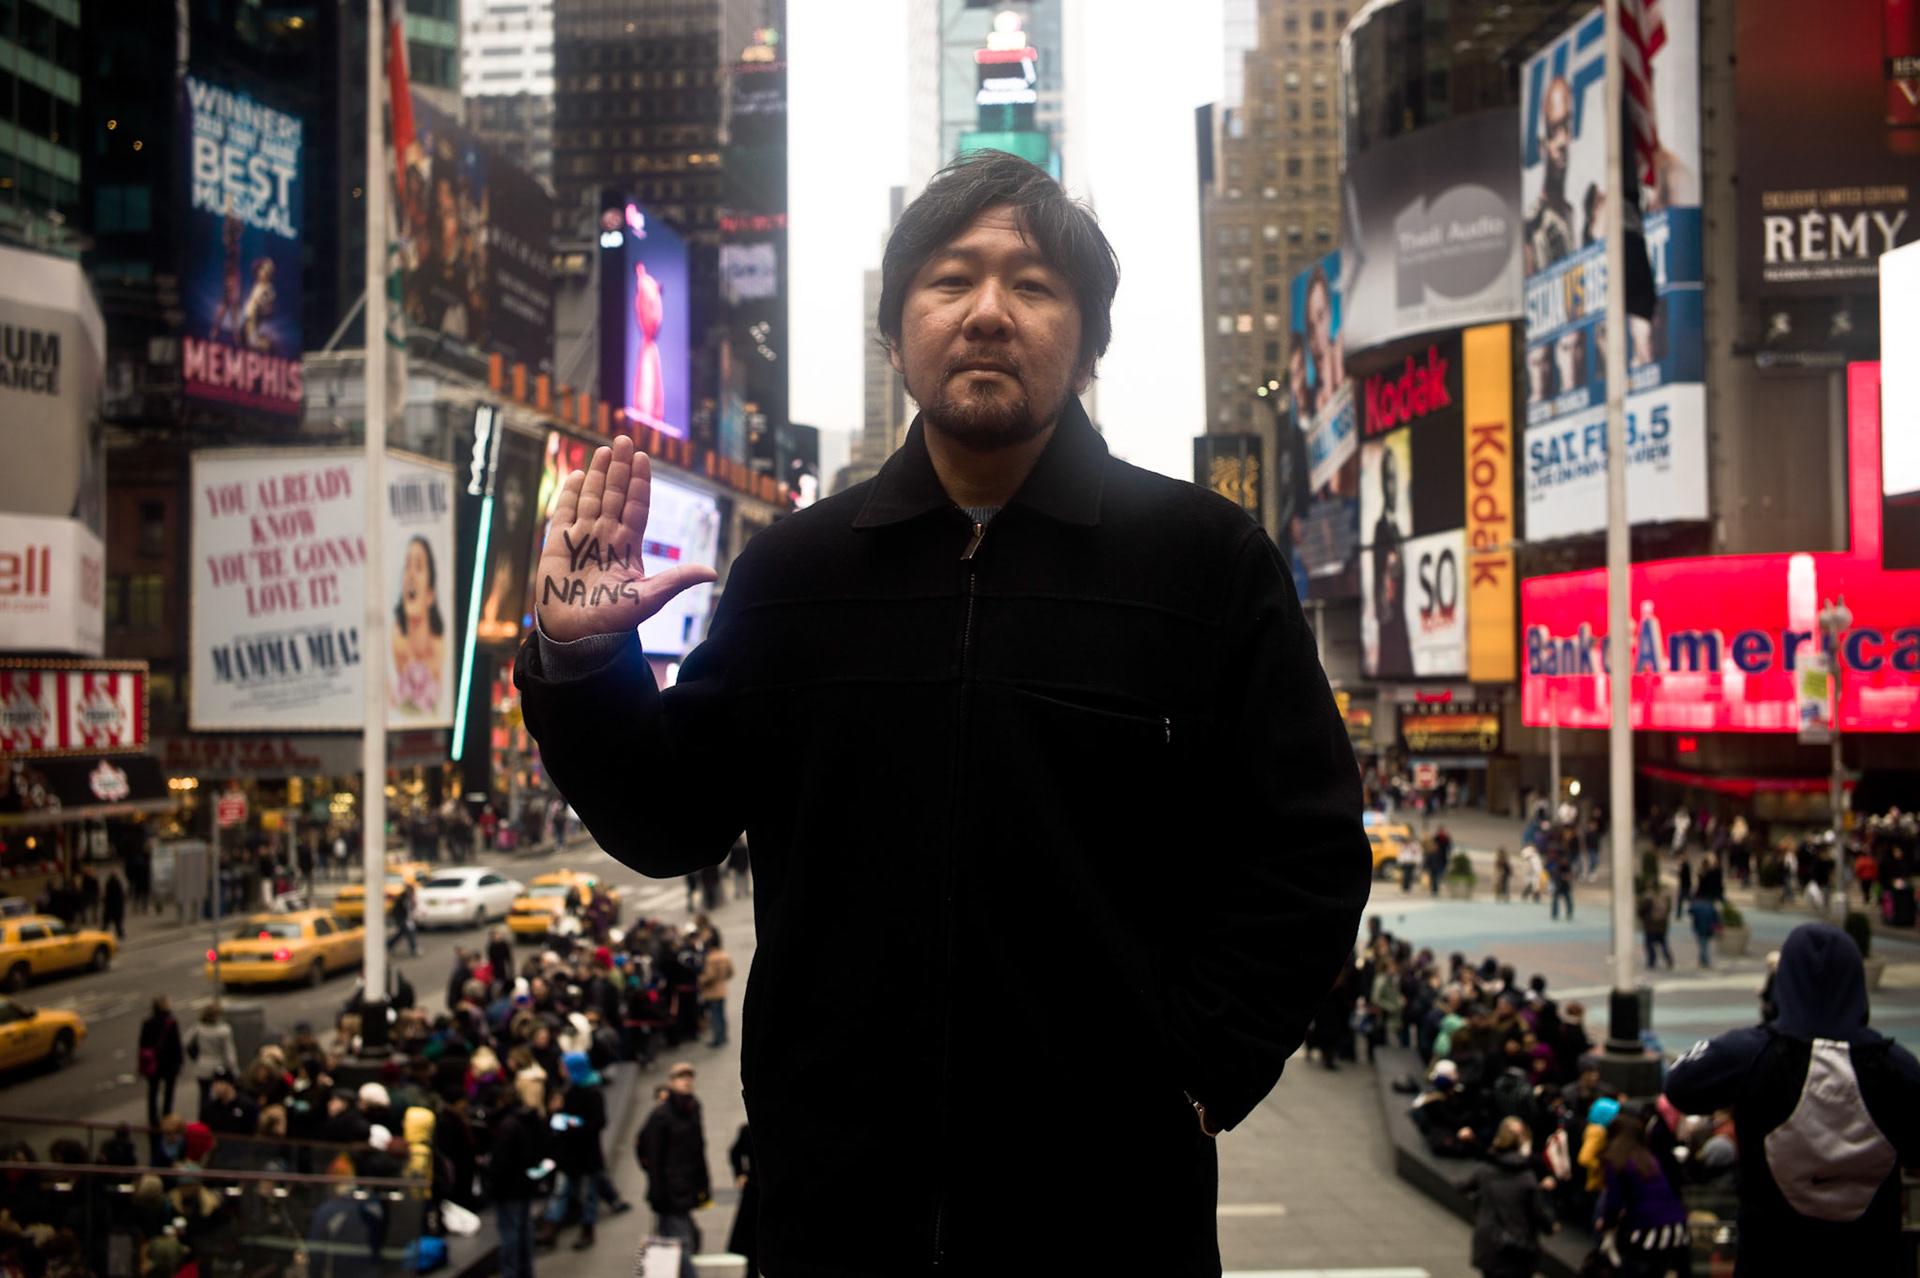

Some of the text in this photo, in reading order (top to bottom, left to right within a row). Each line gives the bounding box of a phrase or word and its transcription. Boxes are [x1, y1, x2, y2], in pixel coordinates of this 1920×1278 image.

[192, 135, 297, 209] BEST
[1762, 184, 1908, 211] EXCLUSIVE LIMITED EDITION
[192, 182, 297, 240] MUSICAL
[1446, 215, 1505, 241] Audio
[1763, 208, 1908, 264] RÉMY
[0, 323, 61, 367] UM
[183, 334, 303, 402] MEMPHIS
[1364, 345, 1451, 436] Kodak
[1650, 404, 1670, 441] 5
[206, 466, 354, 519] YOU ALREADY
[1470, 423, 1508, 589] Kodak
[250, 508, 316, 546] KNOW
[563, 530, 631, 572] YAN
[207, 535, 367, 589] YOU'RE GONNA
[1419, 549, 1458, 618] SO
[246, 573, 340, 619] LOVE IT!
[542, 574, 640, 606] NAING
[211, 626, 361, 685] MAMMA MIA!
[1528, 625, 1595, 675] Bank
